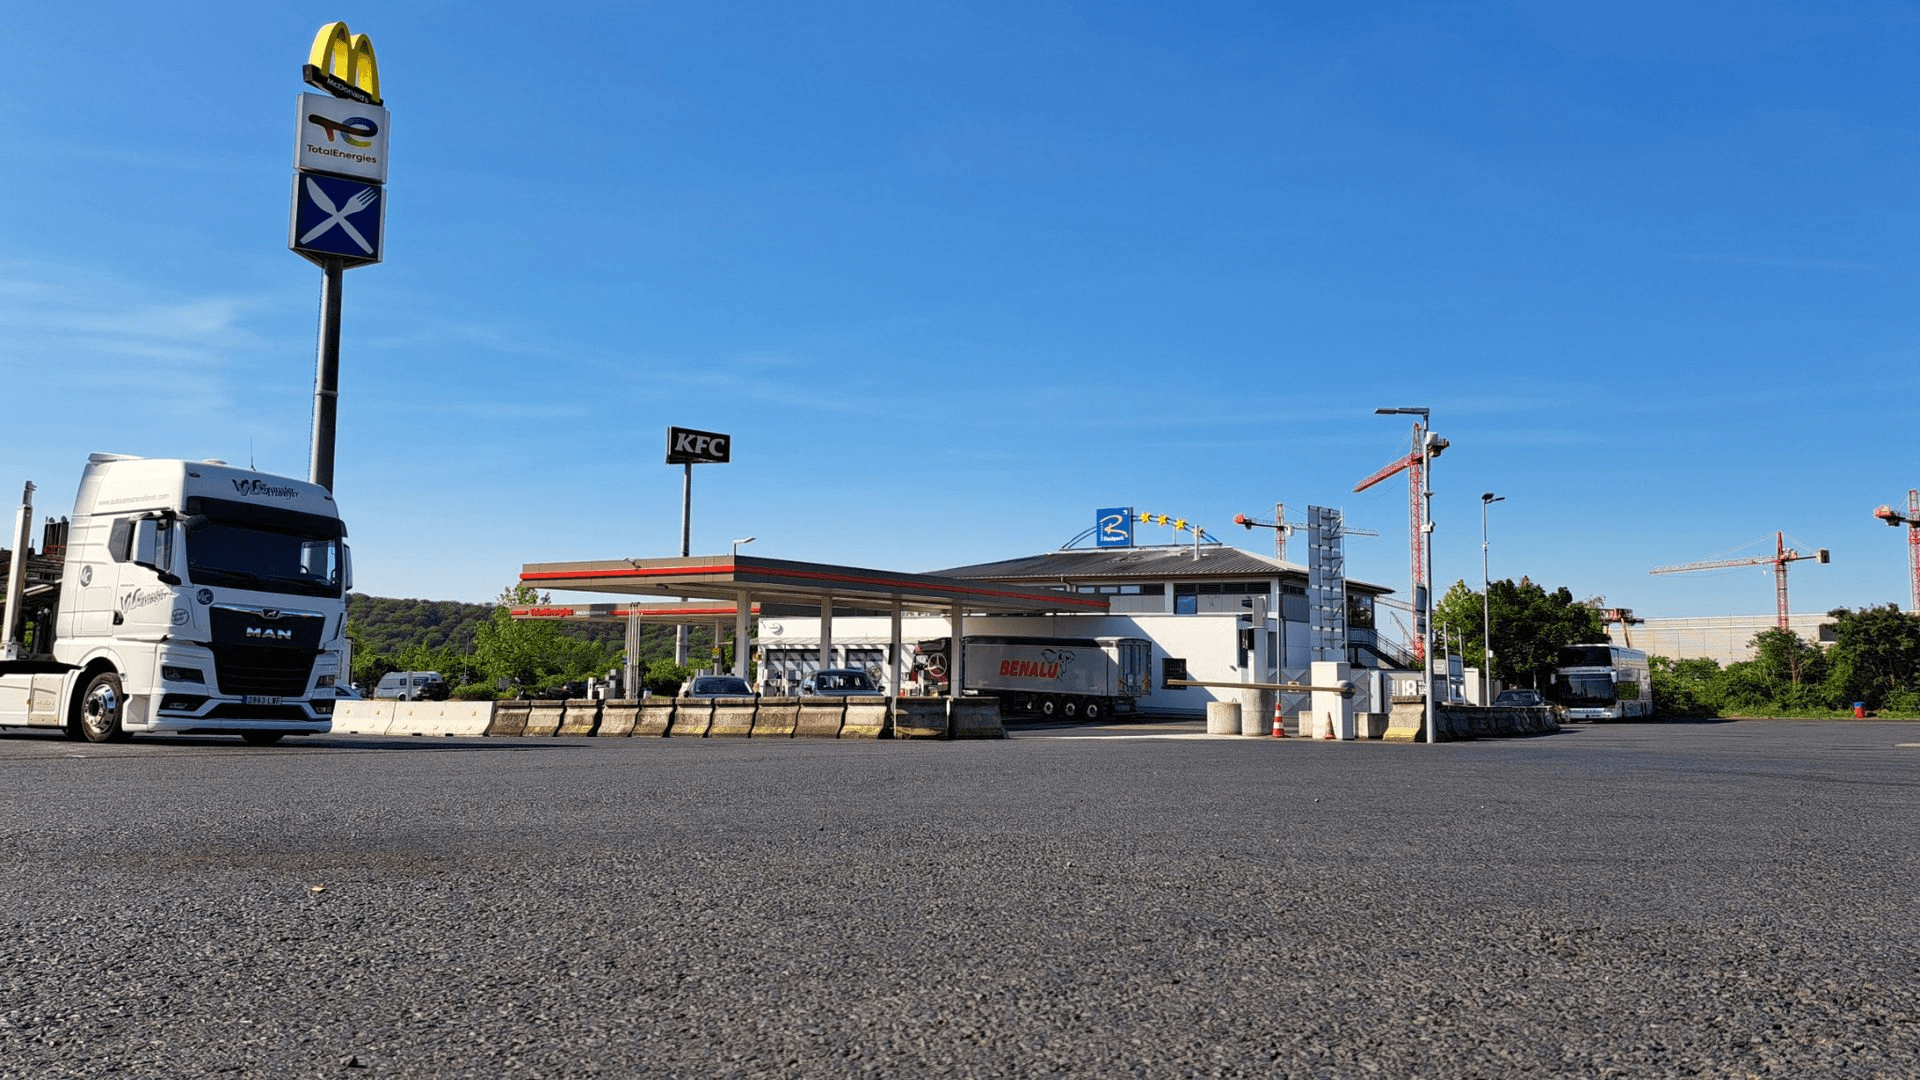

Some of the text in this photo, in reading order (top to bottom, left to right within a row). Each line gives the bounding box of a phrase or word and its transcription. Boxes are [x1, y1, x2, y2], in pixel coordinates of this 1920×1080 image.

[326, 77, 370, 104] McDonald's
[306, 144, 377, 164] TotalEnergies
[675, 433, 725, 457] KFC
[246, 627, 292, 640] MAN
[1000, 660, 1059, 679] BENALU
